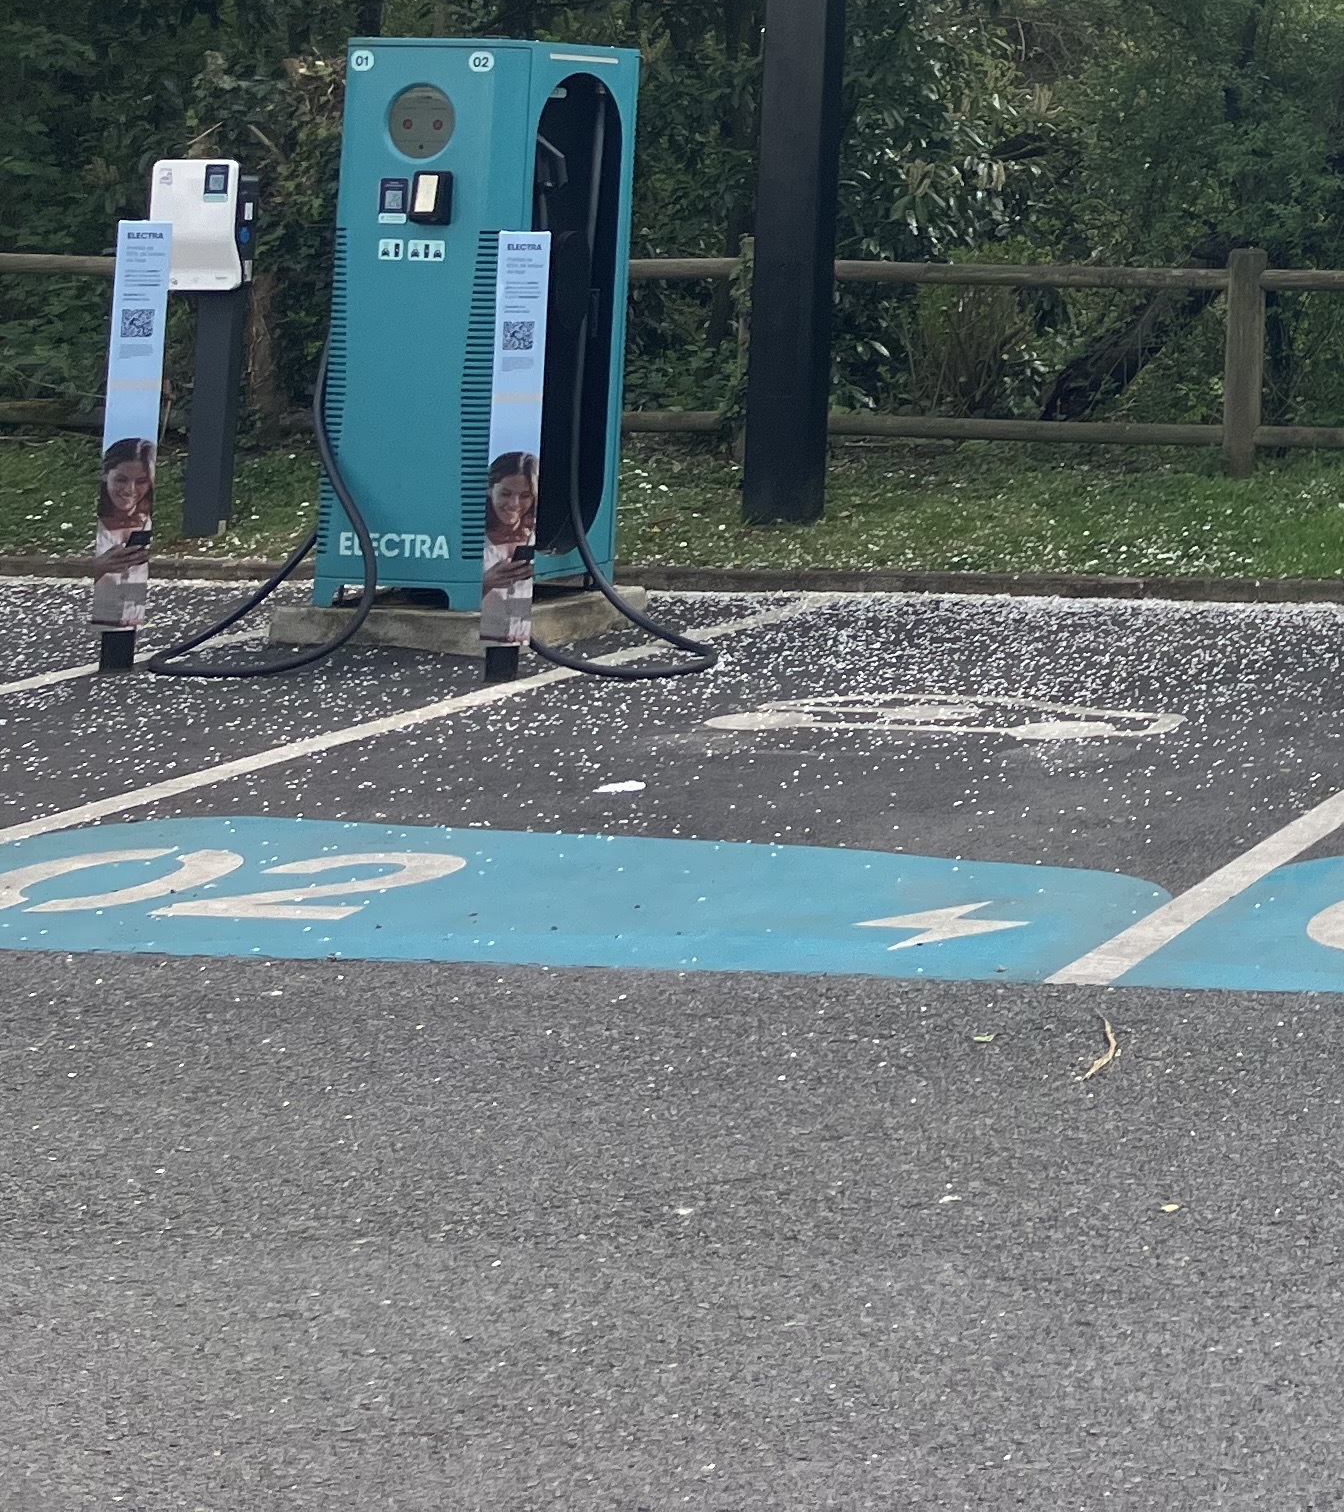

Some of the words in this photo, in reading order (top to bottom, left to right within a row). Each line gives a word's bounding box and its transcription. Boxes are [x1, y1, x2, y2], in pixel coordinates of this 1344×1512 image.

[355, 55, 370, 67] 01
[472, 56, 490, 68] 02
[127, 231, 165, 240] ELECTRA
[0, 848, 468, 921] 02
